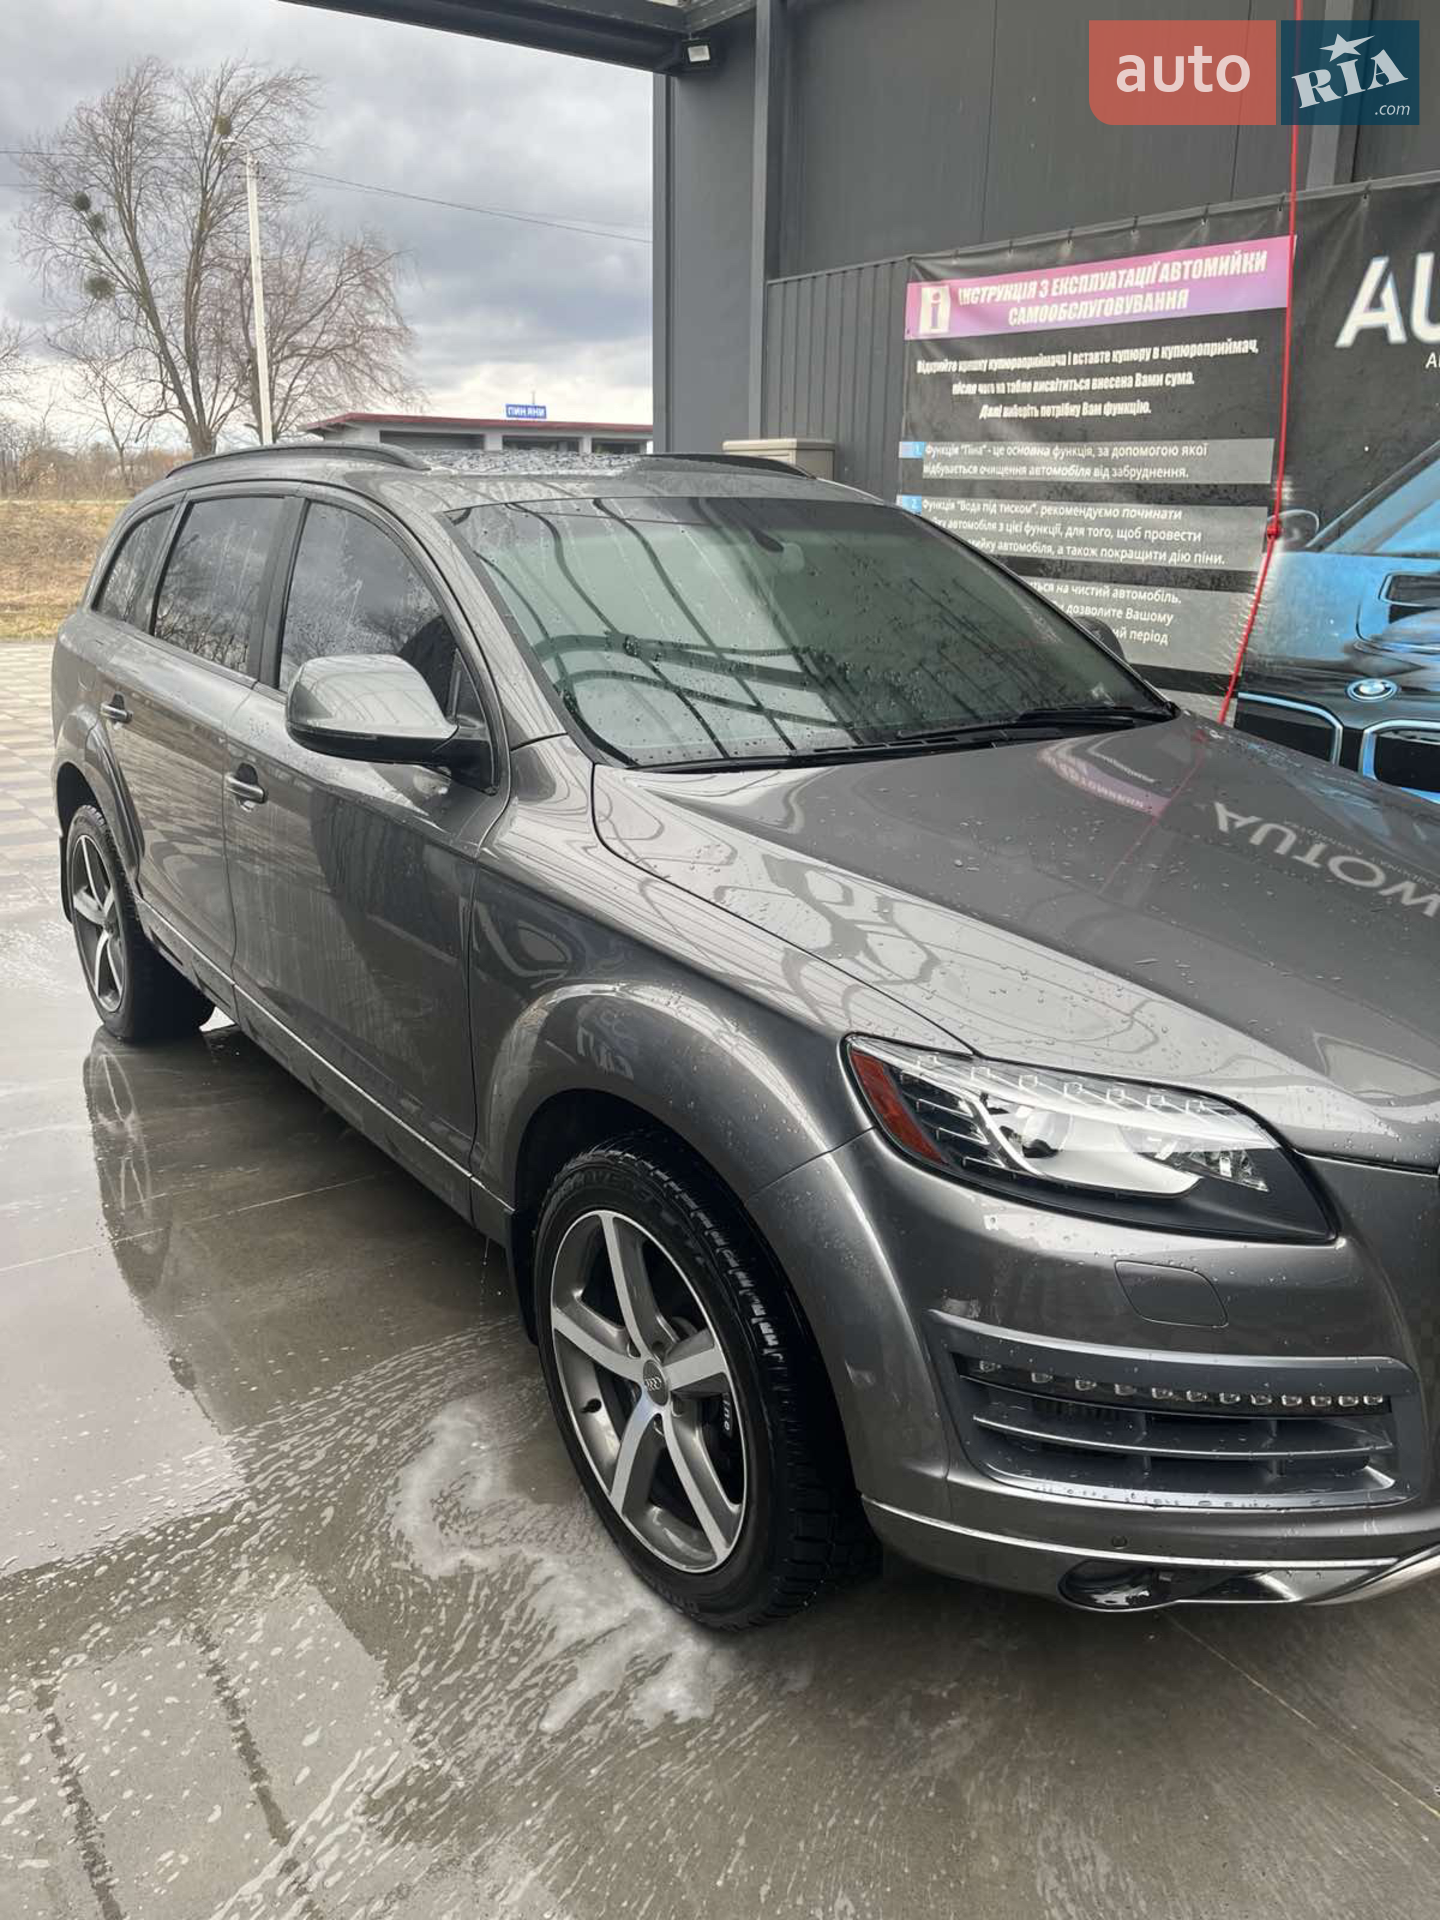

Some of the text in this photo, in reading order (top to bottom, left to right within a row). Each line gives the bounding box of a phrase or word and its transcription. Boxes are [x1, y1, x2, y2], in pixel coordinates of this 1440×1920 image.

[958, 250, 1267, 306] ІНСТРУКЦІЯ З ЕКСПЛУАТАЦІЇ АВТОМИЙКИ
[1009, 288, 1189, 326] САМООБСЛУГОВУВАННЯ
[1072, 350, 1111, 367] вставте
[1112, 347, 1152, 364] купюру
[1152, 346, 1160, 360] в
[1160, 338, 1259, 361] купюроприймач,
[1091, 374, 1134, 391] внесена
[1134, 372, 1164, 388] Вами
[1164, 372, 1195, 387] сума.
[1081, 401, 1103, 416] Вам
[1103, 399, 1152, 416] функцію.
[992, 446, 1005, 457] це
[1006, 445, 1051, 456] основна
[1052, 444, 1096, 459] функція,
[1098, 446, 1110, 457] за
[1111, 444, 1179, 458] допомогою
[1181, 443, 1209, 457] якої
[1028, 464, 1092, 476] автомобіля
[1093, 466, 1110, 479] від
[1111, 465, 1189, 480] забруднення.
[982, 502, 997, 515] під
[1040, 505, 1120, 521] рекомендуємо
[1121, 507, 1183, 520] починати
[947, 519, 997, 531] автомобіля
[1023, 520, 1063, 537] функції,
[1064, 526, 1085, 538] для
[1086, 527, 1114, 540] того,
[1116, 527, 1142, 541] щоб
[1144, 529, 1202, 543] провести
[997, 539, 1055, 556] автомобіля,
[1057, 545, 1064, 555] а
[1065, 545, 1098, 558] також
[1100, 546, 1167, 562] покращити
[1168, 550, 1191, 566] дію
[1193, 552, 1225, 565] піни.
[1055, 584, 1070, 594] на
[1071, 585, 1111, 598] чистий
[1112, 588, 1182, 604] автомобіль.
[1066, 604, 1124, 619] дозволите
[1125, 607, 1174, 627] Вашому
[1129, 629, 1170, 646] період
